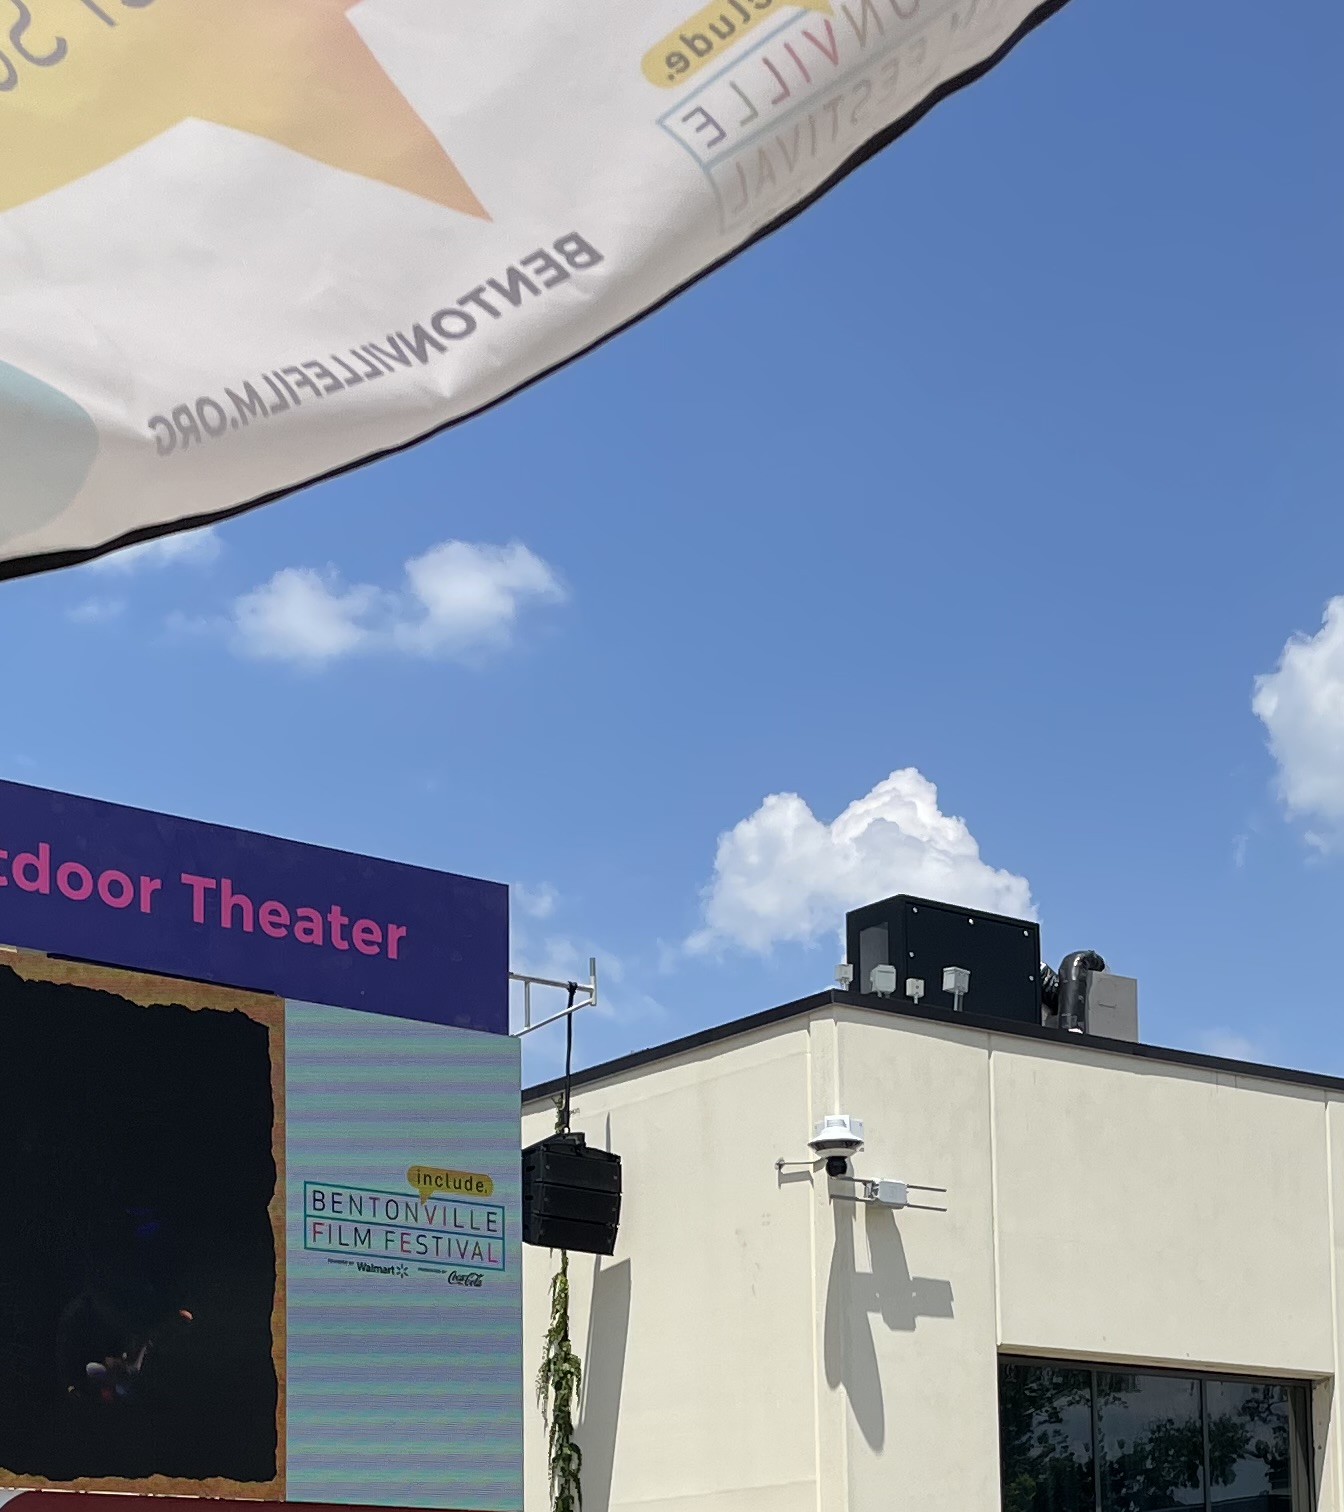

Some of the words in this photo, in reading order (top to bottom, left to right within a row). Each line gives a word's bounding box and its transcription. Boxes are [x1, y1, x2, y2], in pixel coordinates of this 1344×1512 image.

[180, 873, 408, 961] Theater
[416, 1168, 488, 1194] include.
[312, 1189, 498, 1233] BENTONVILLE
[312, 1222, 372, 1249] FILM
[384, 1230, 499, 1264] FESTIVAL
[356, 1261, 395, 1275] Walmart
